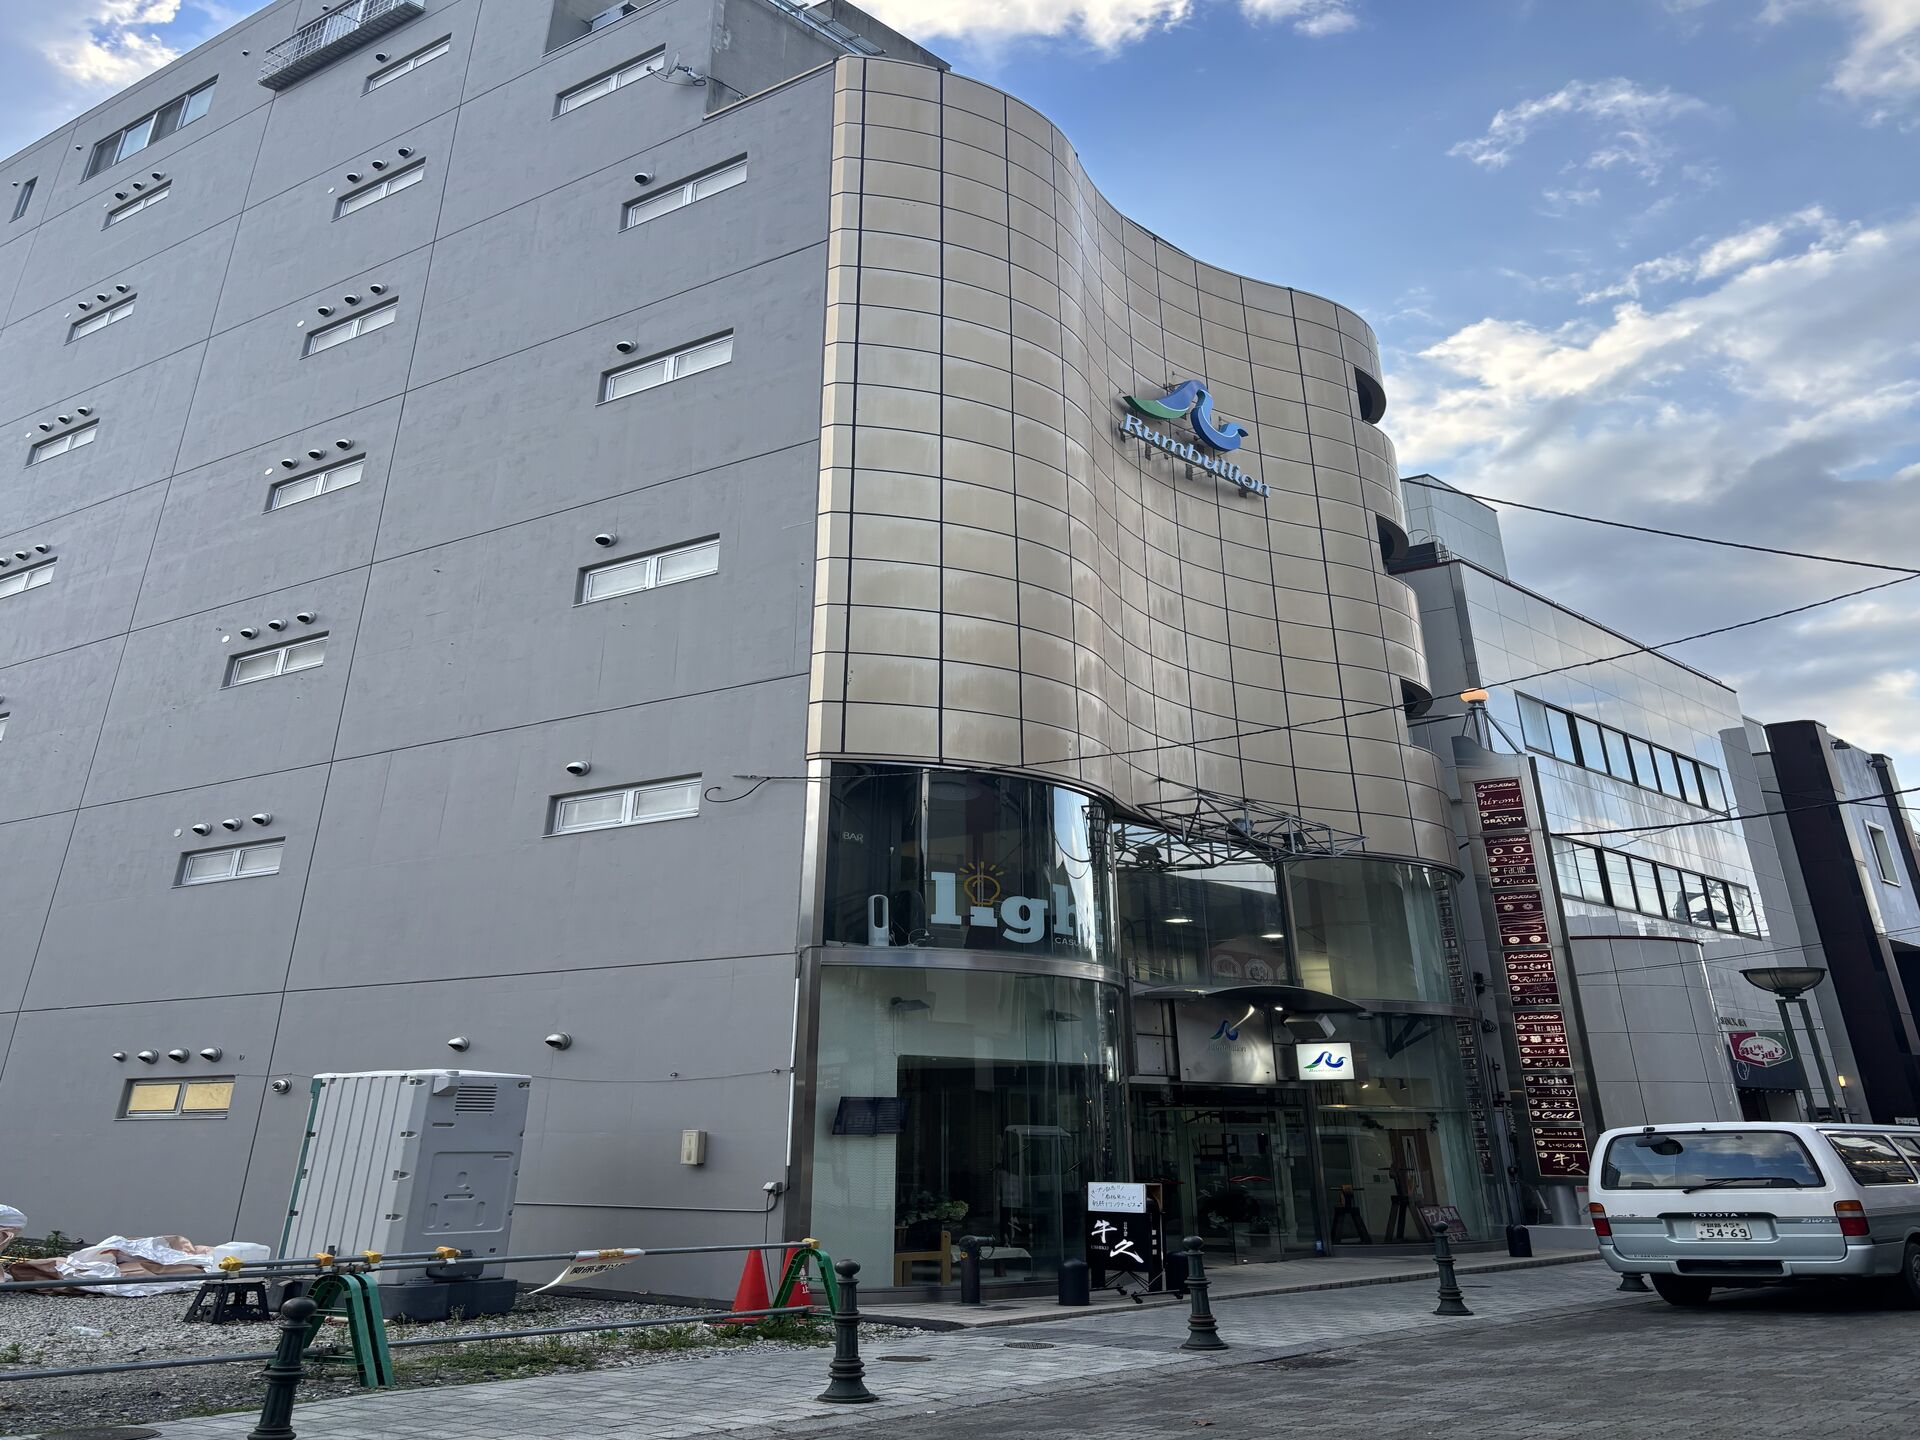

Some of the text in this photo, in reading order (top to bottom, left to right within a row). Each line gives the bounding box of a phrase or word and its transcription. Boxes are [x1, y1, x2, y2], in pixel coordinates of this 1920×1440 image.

[1122, 413, 1271, 498] Rumbullion
[1483, 816, 1522, 825] GRAVITY
[843, 831, 864, 844] BAR
[1551, 1088, 1573, 1096] Ray
[1091, 1219, 1144, 1263] 牛久
